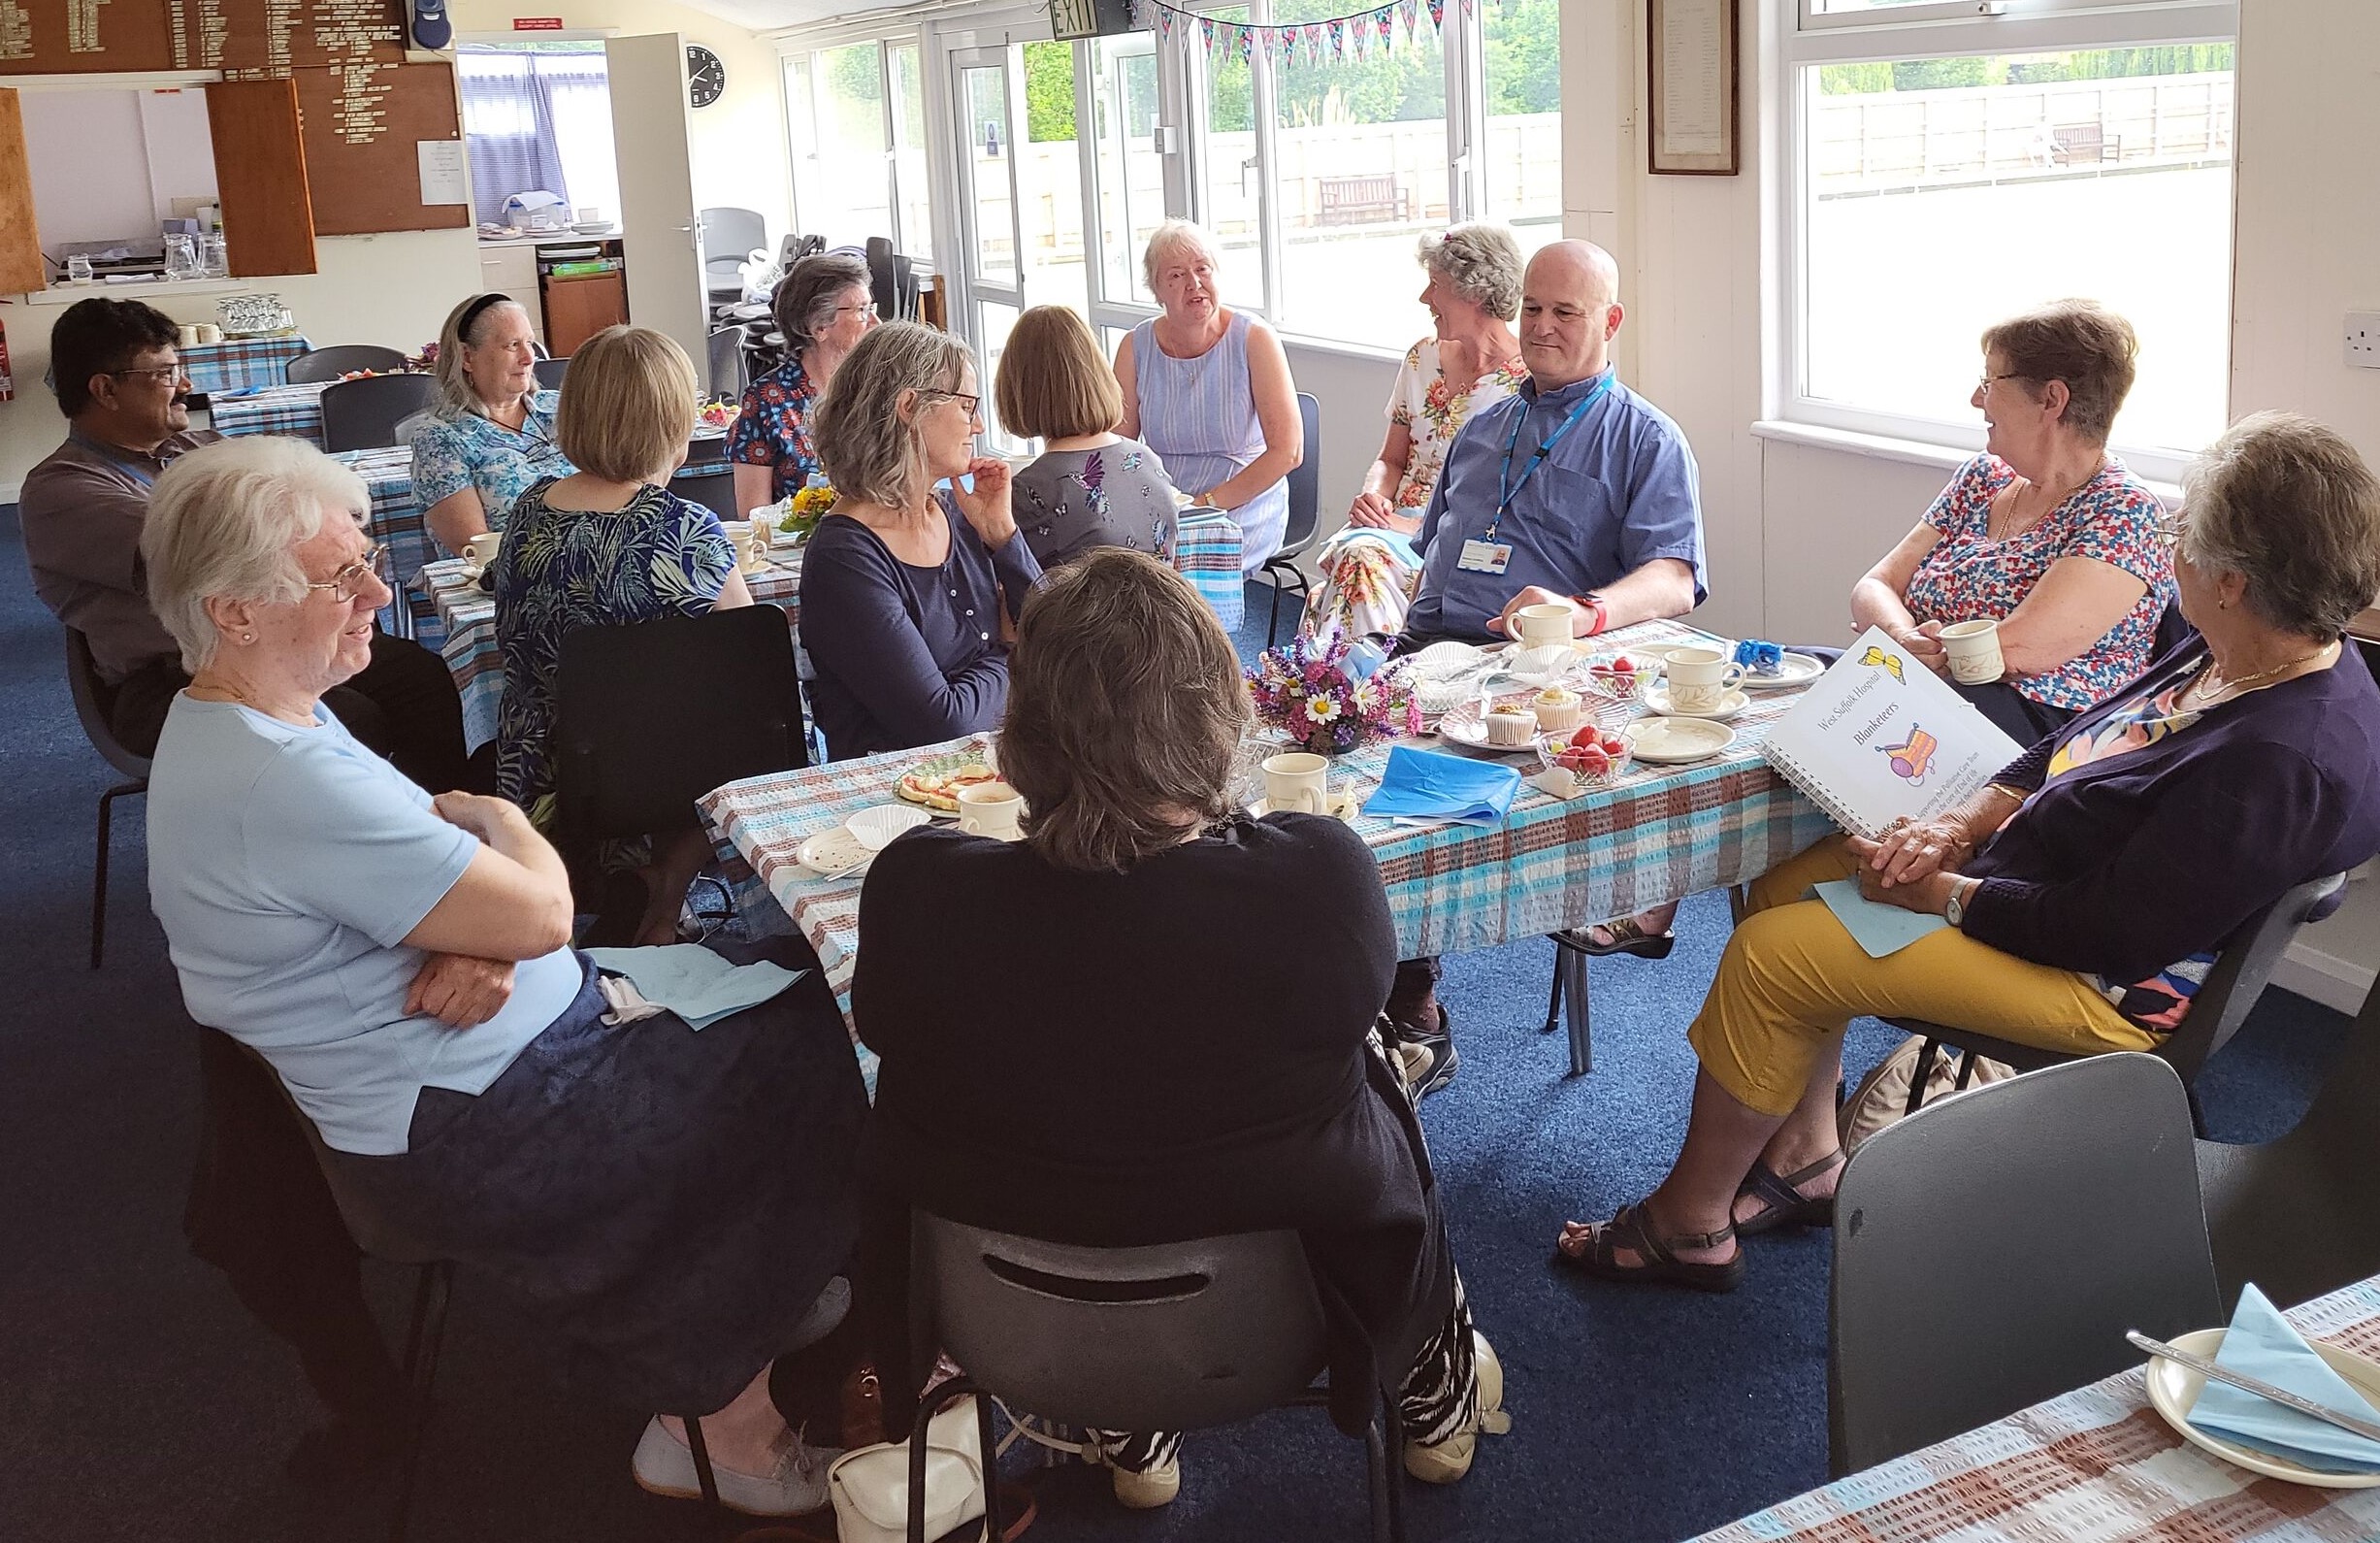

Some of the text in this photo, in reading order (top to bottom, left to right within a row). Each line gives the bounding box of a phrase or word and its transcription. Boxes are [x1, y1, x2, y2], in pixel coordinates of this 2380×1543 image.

[1817, 671, 1881, 731] West Suffolk Hospital
[1853, 702, 1899, 745] Blanketeers
